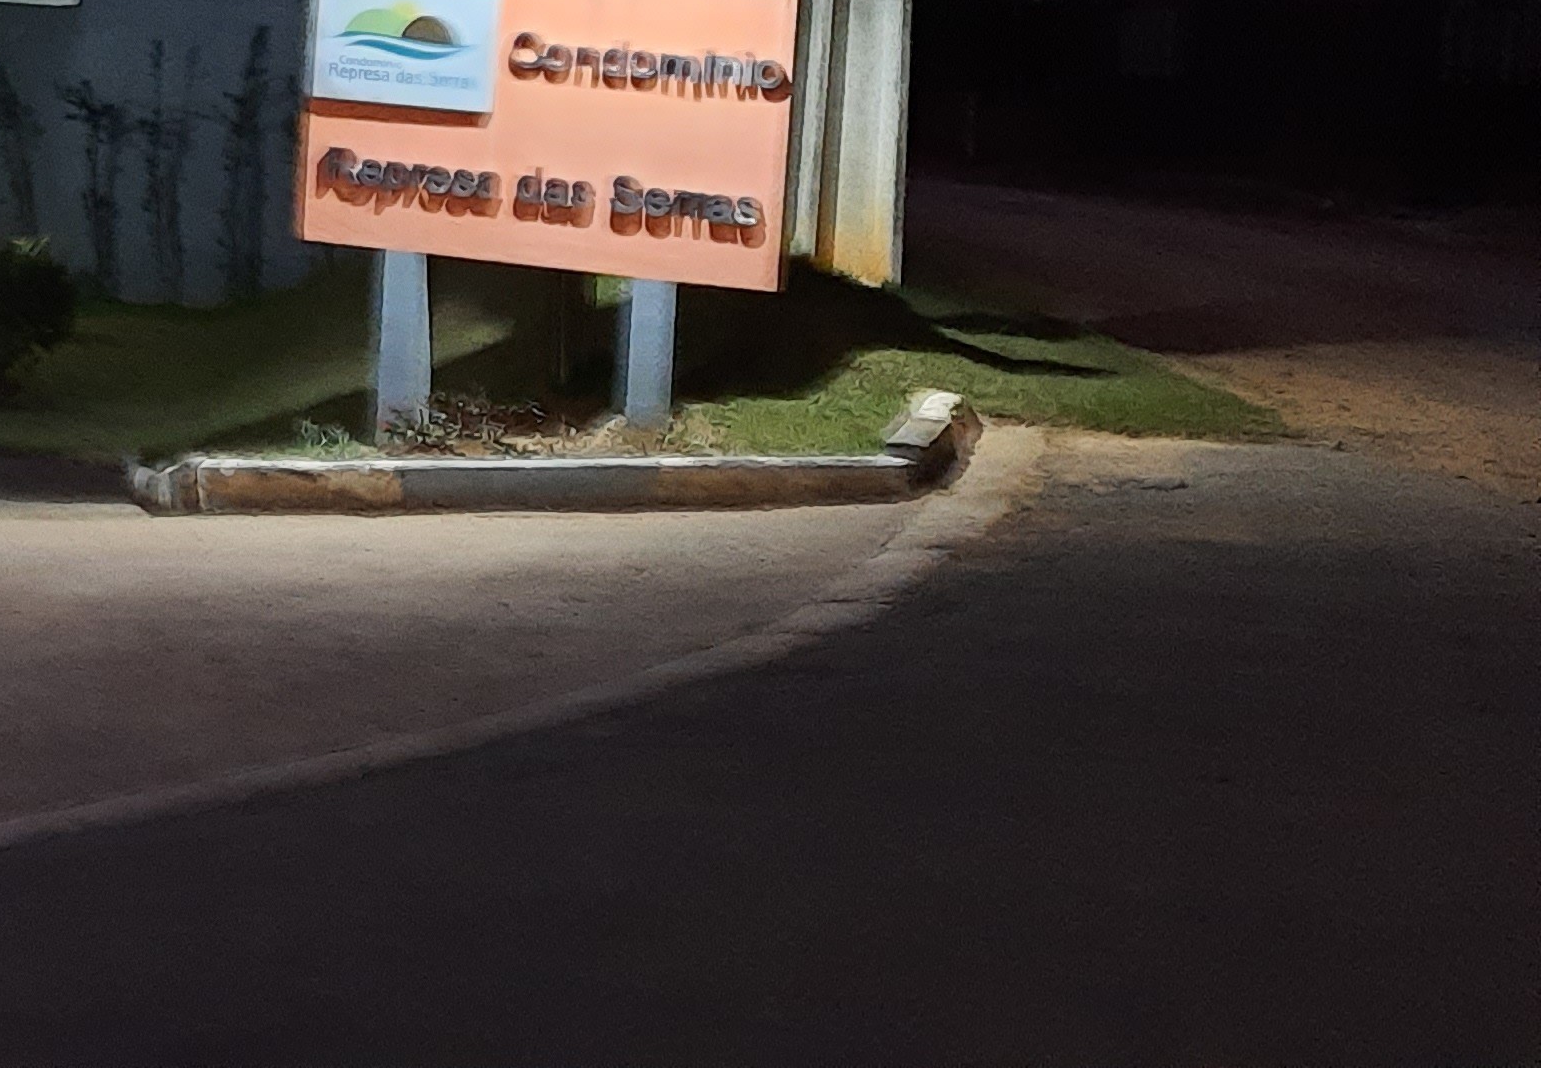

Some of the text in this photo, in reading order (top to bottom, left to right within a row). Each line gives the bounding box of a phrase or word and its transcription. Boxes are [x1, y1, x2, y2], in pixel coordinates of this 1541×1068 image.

[329, 62, 390, 83] Represa
[395, 69, 423, 84] das
[611, 176, 765, 234] Serras
